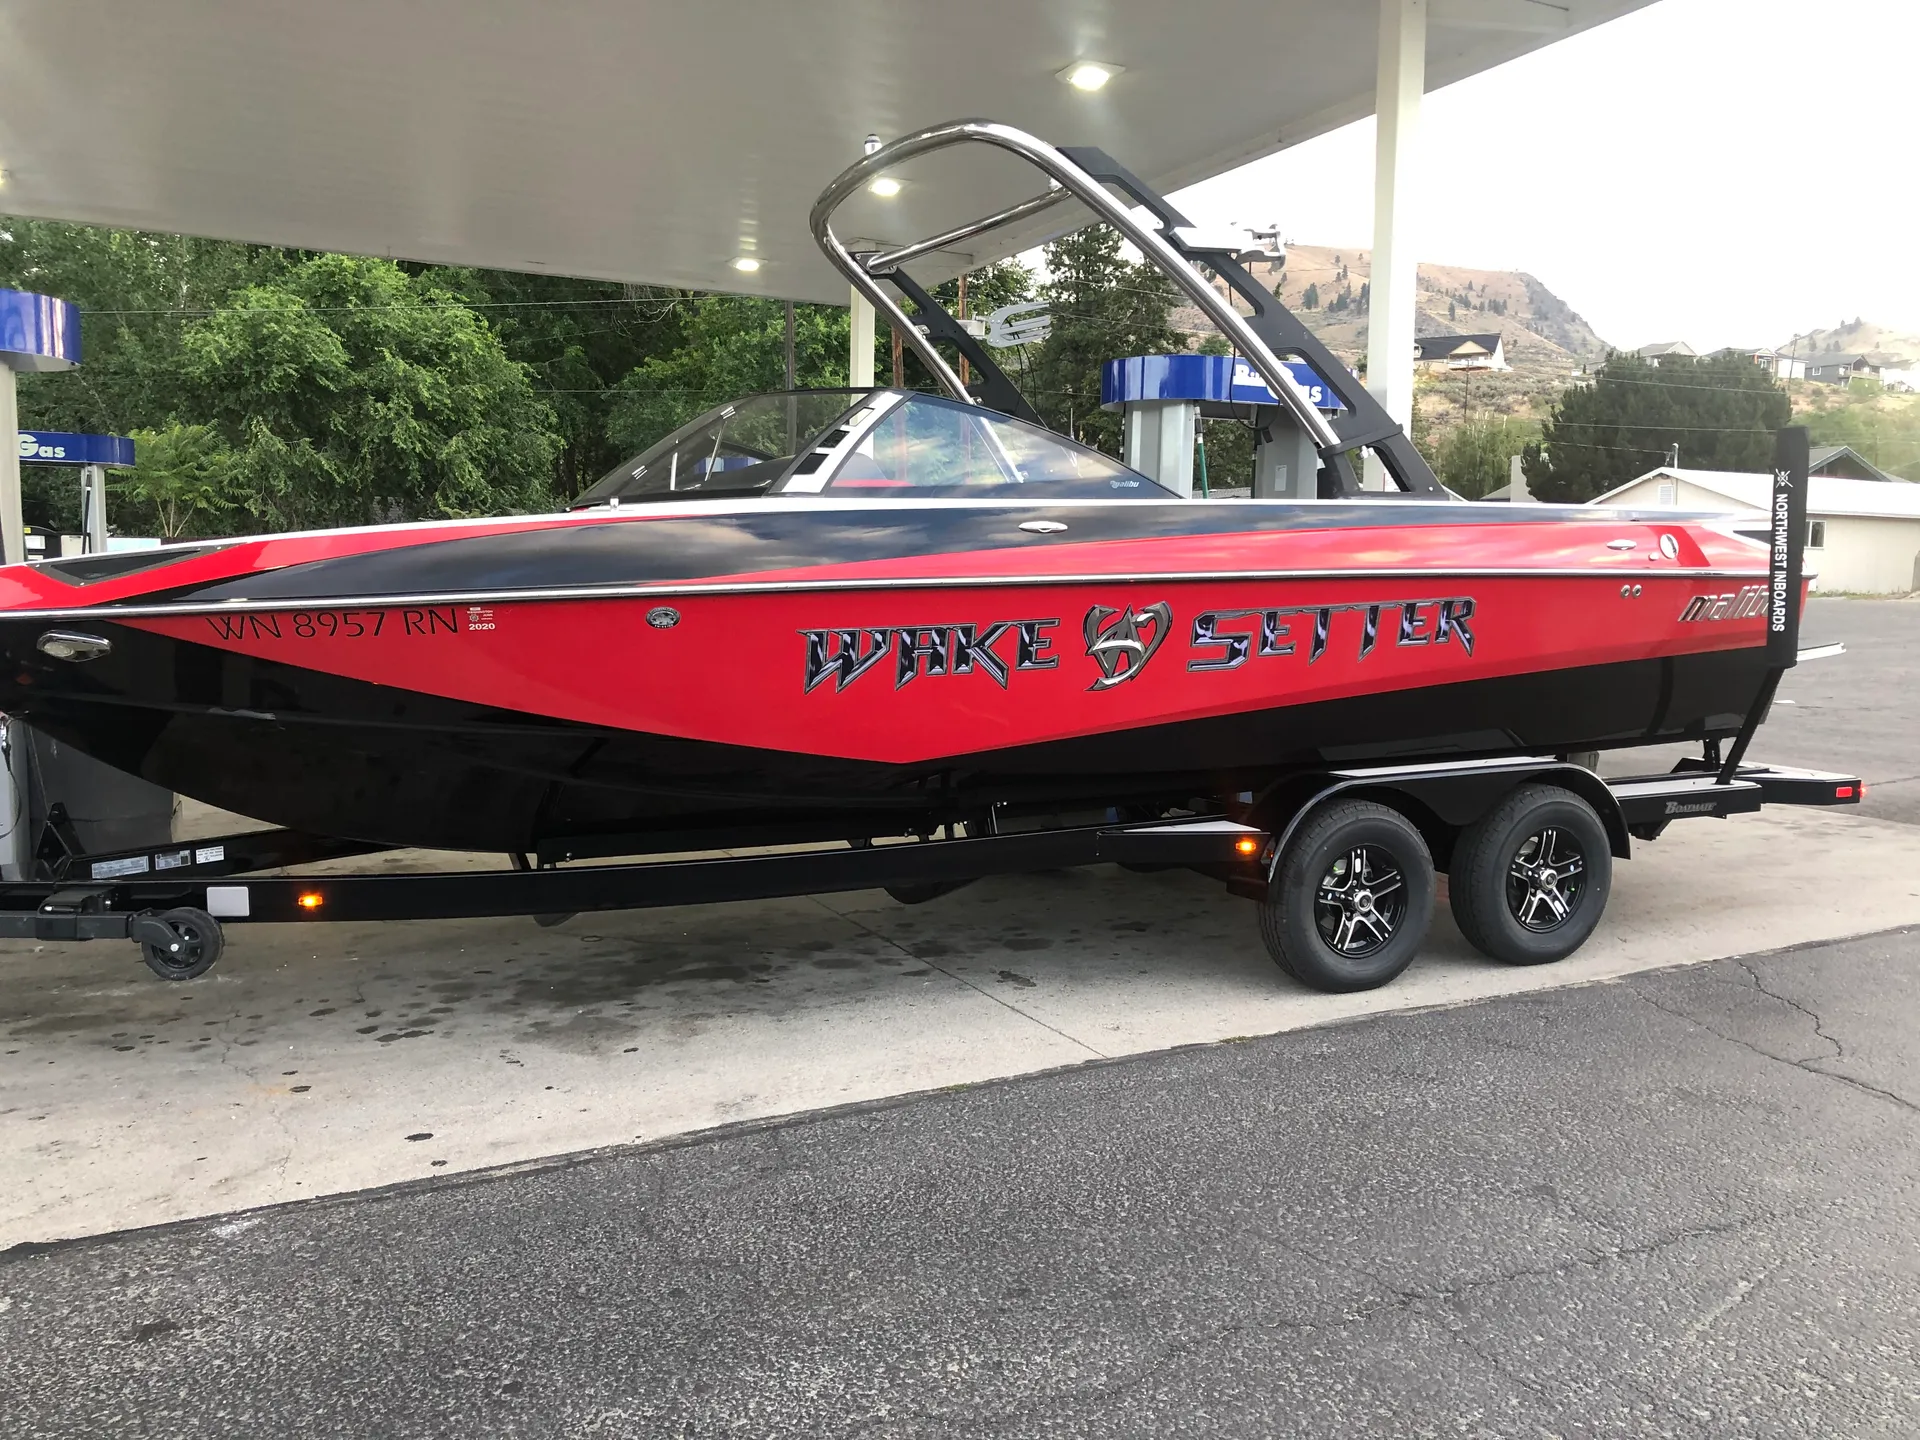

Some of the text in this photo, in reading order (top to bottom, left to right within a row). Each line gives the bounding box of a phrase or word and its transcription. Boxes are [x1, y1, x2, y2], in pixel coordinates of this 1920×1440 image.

[18, 434, 66, 458] Gas
[1772, 493, 1789, 632] NORTHWEST INBOARDS
[205, 607, 459, 640] WN 8957 RN
[468, 622, 496, 631] 2020
[796, 596, 1477, 696] WAKE SETTER
